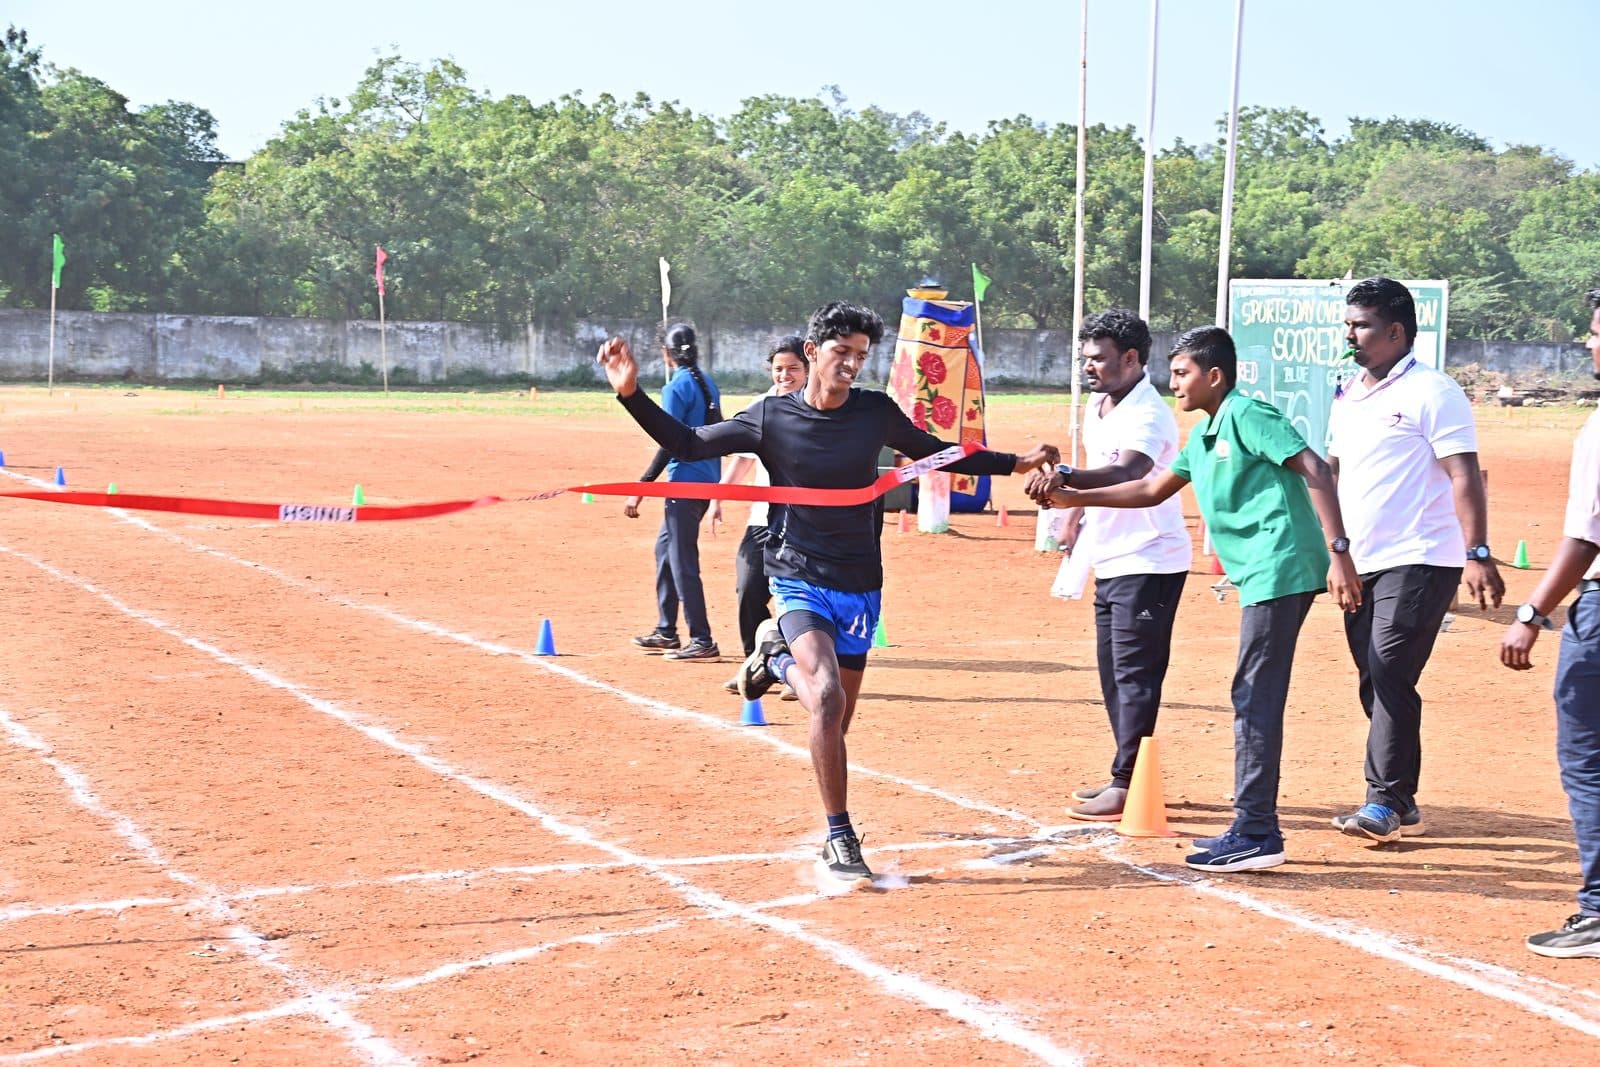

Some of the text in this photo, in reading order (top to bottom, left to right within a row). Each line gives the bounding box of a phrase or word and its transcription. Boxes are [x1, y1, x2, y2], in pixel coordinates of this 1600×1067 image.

[1241, 298, 1291, 326] SPORTS
[1292, 298, 1314, 325] DAY
[1271, 326, 1347, 367] SCOREB
[1236, 361, 1258, 384] RED
[1283, 365, 1309, 383] BLUE
[282, 505, 355, 521] FINISH
[845, 613, 868, 640] 11
